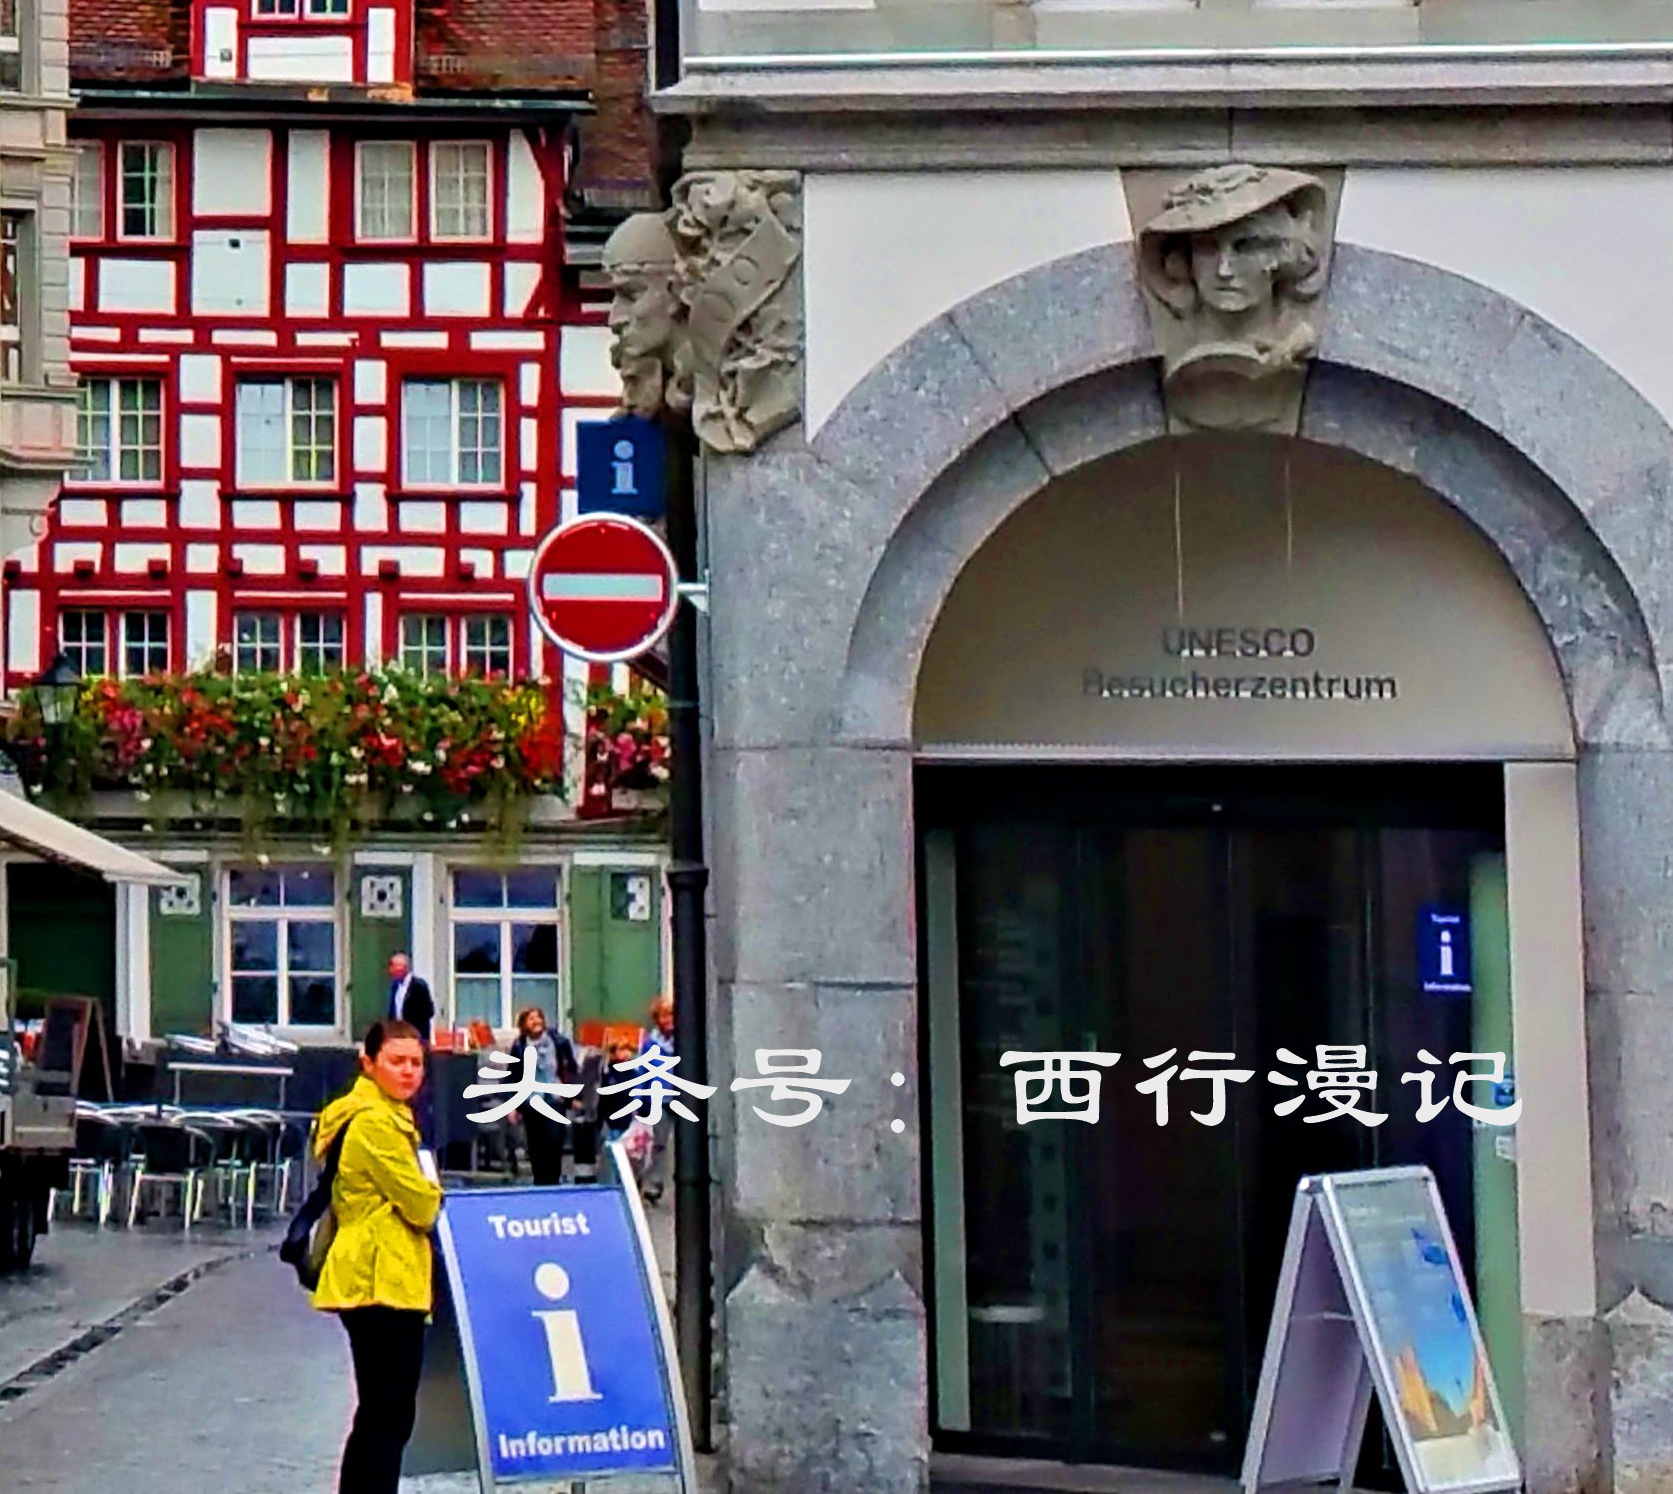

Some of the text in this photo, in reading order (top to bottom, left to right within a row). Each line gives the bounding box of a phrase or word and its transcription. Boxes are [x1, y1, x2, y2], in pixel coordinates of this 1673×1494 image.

[1161, 626, 1315, 657] UNESCO
[1081, 666, 1398, 699] Besucherzentrum
[486, 1211, 591, 1242] Tourist
[498, 1425, 666, 1462] Information
